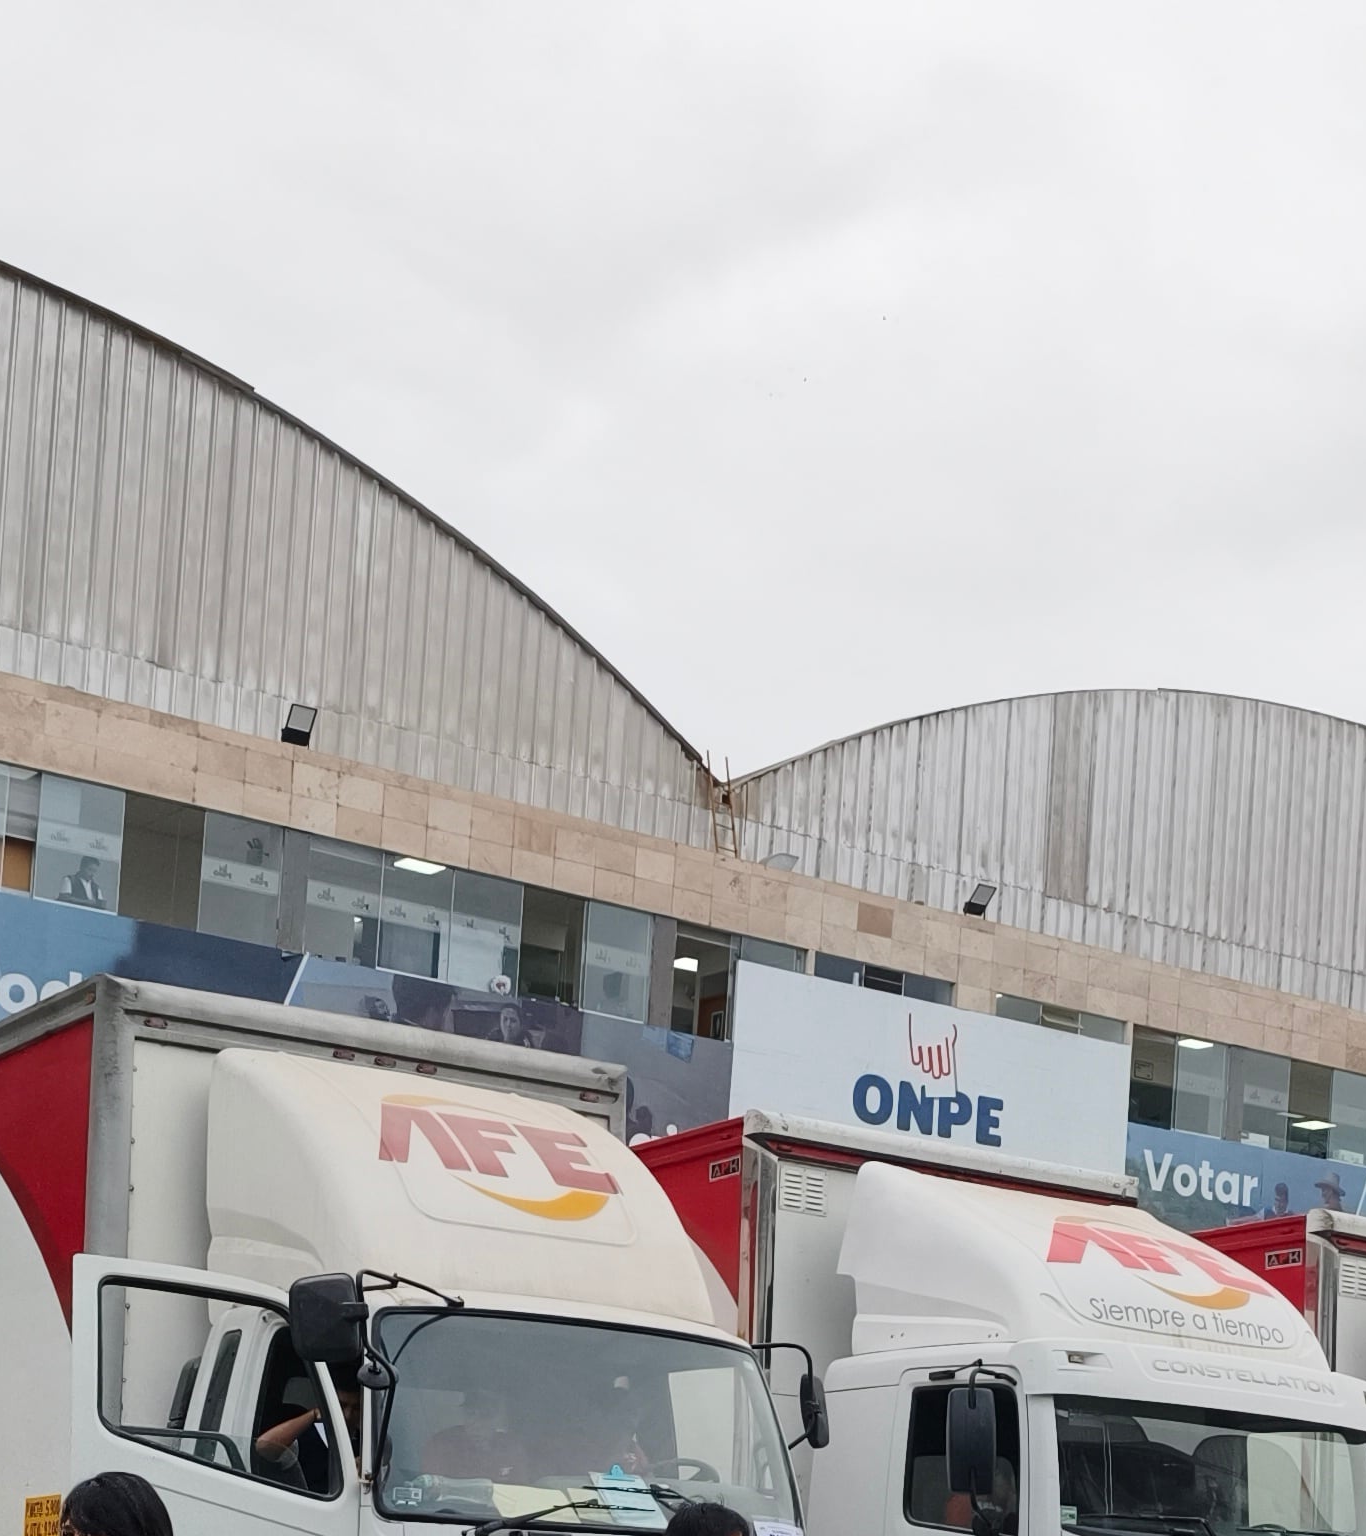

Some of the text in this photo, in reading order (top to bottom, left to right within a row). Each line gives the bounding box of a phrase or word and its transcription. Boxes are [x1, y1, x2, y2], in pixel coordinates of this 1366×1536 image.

[852, 1075, 1004, 1148] ONPE
[379, 1102, 623, 1195] AFE
[1143, 1149, 1259, 1207] Votar
[1089, 1297, 1284, 1346] Siempre a tiempo
[1152, 1358, 1336, 1397] CONSTELLATION
